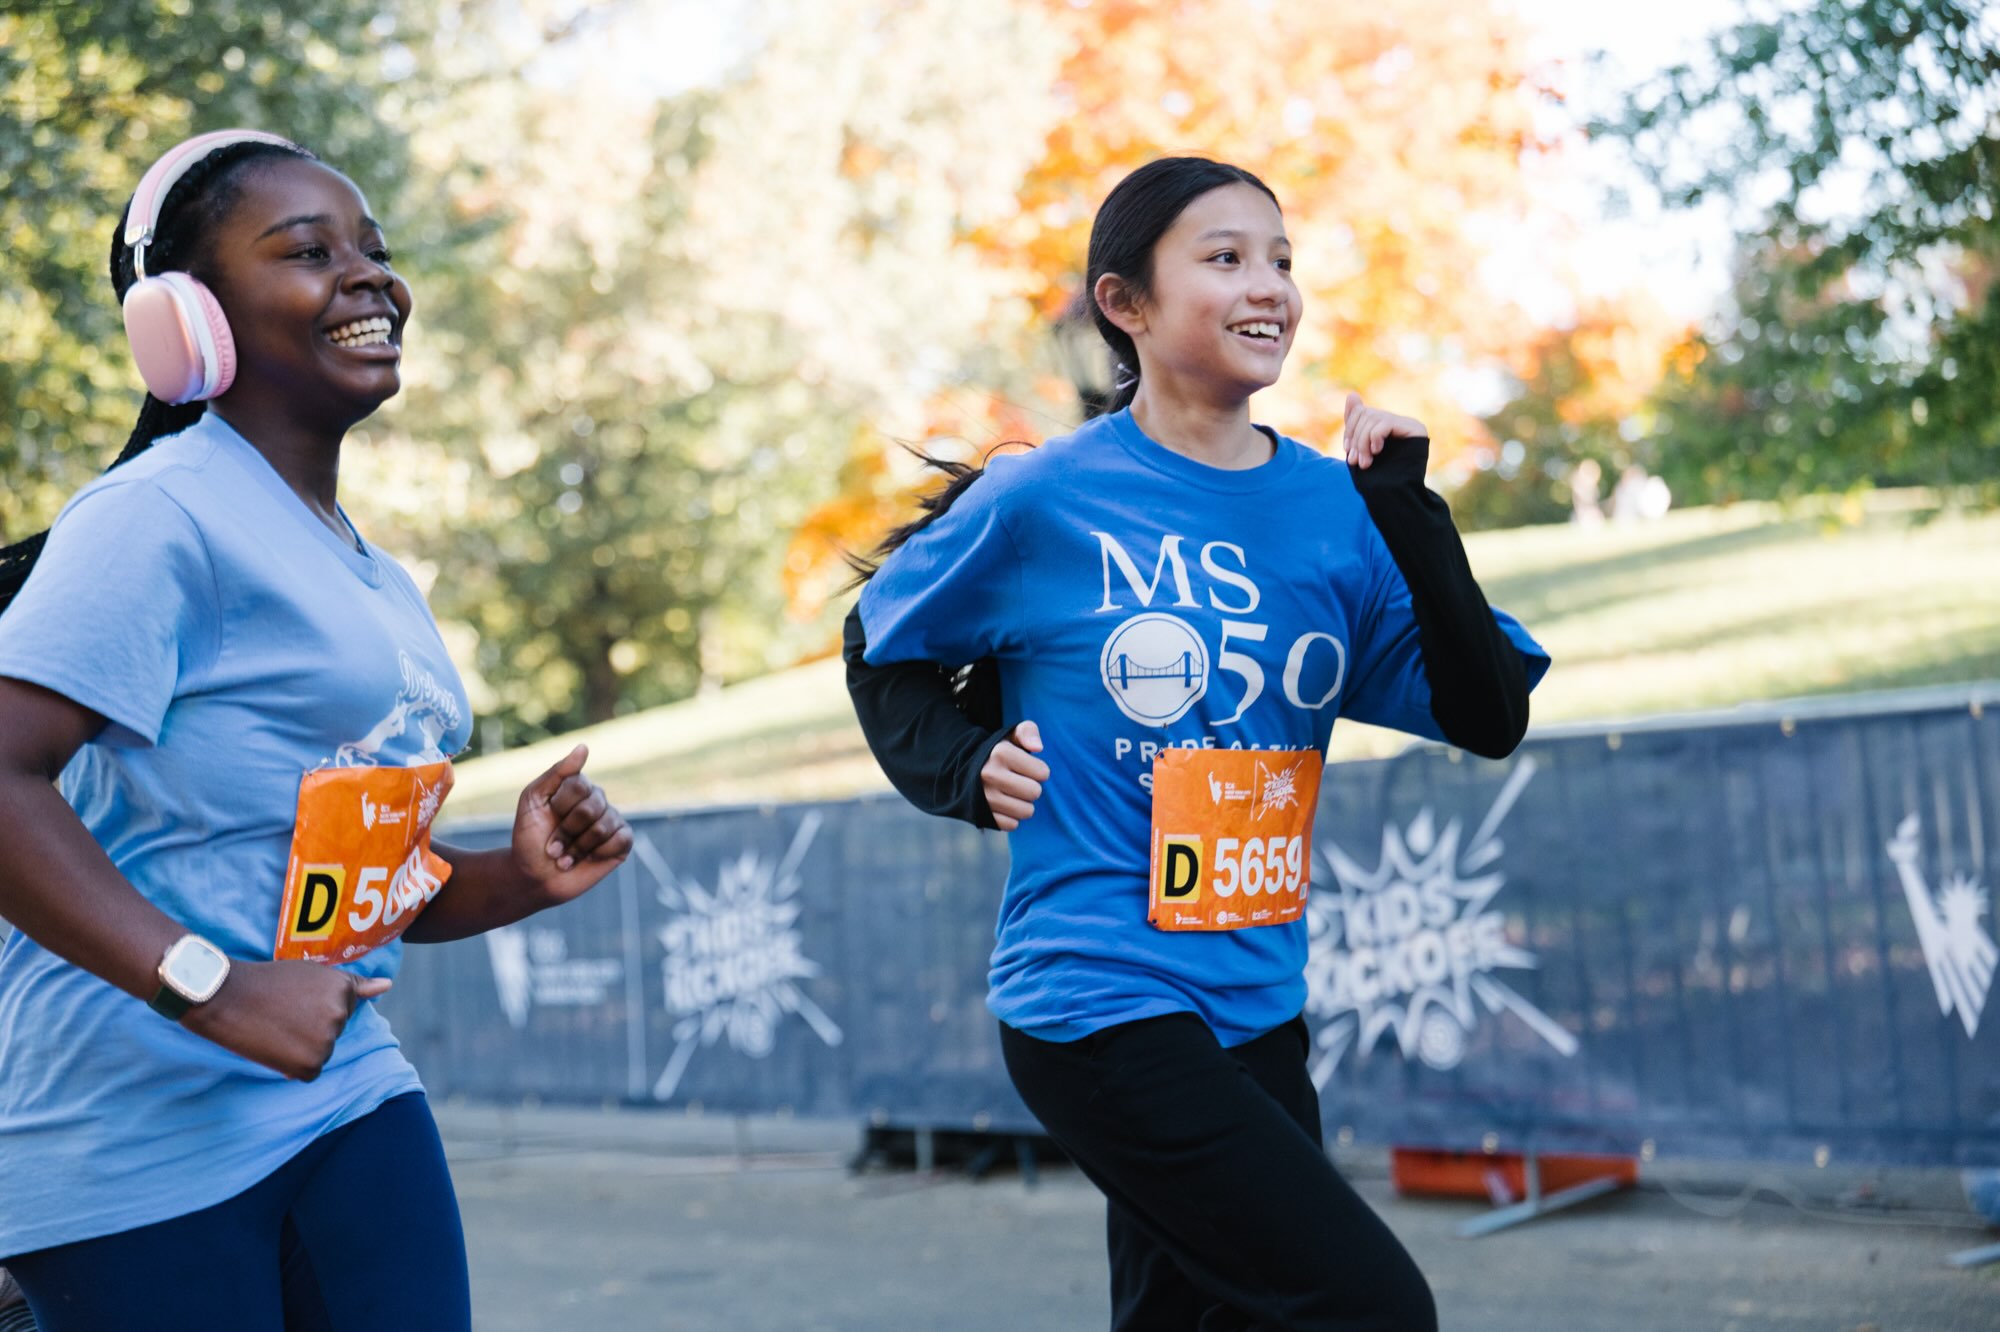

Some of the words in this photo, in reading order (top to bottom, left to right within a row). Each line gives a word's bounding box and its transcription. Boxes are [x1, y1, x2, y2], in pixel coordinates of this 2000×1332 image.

[1090, 531, 1260, 614] MS
[1209, 619, 1346, 727] 50
[296, 873, 338, 932] D
[1165, 844, 1199, 897] D
[1213, 835, 1303, 898] 5659
